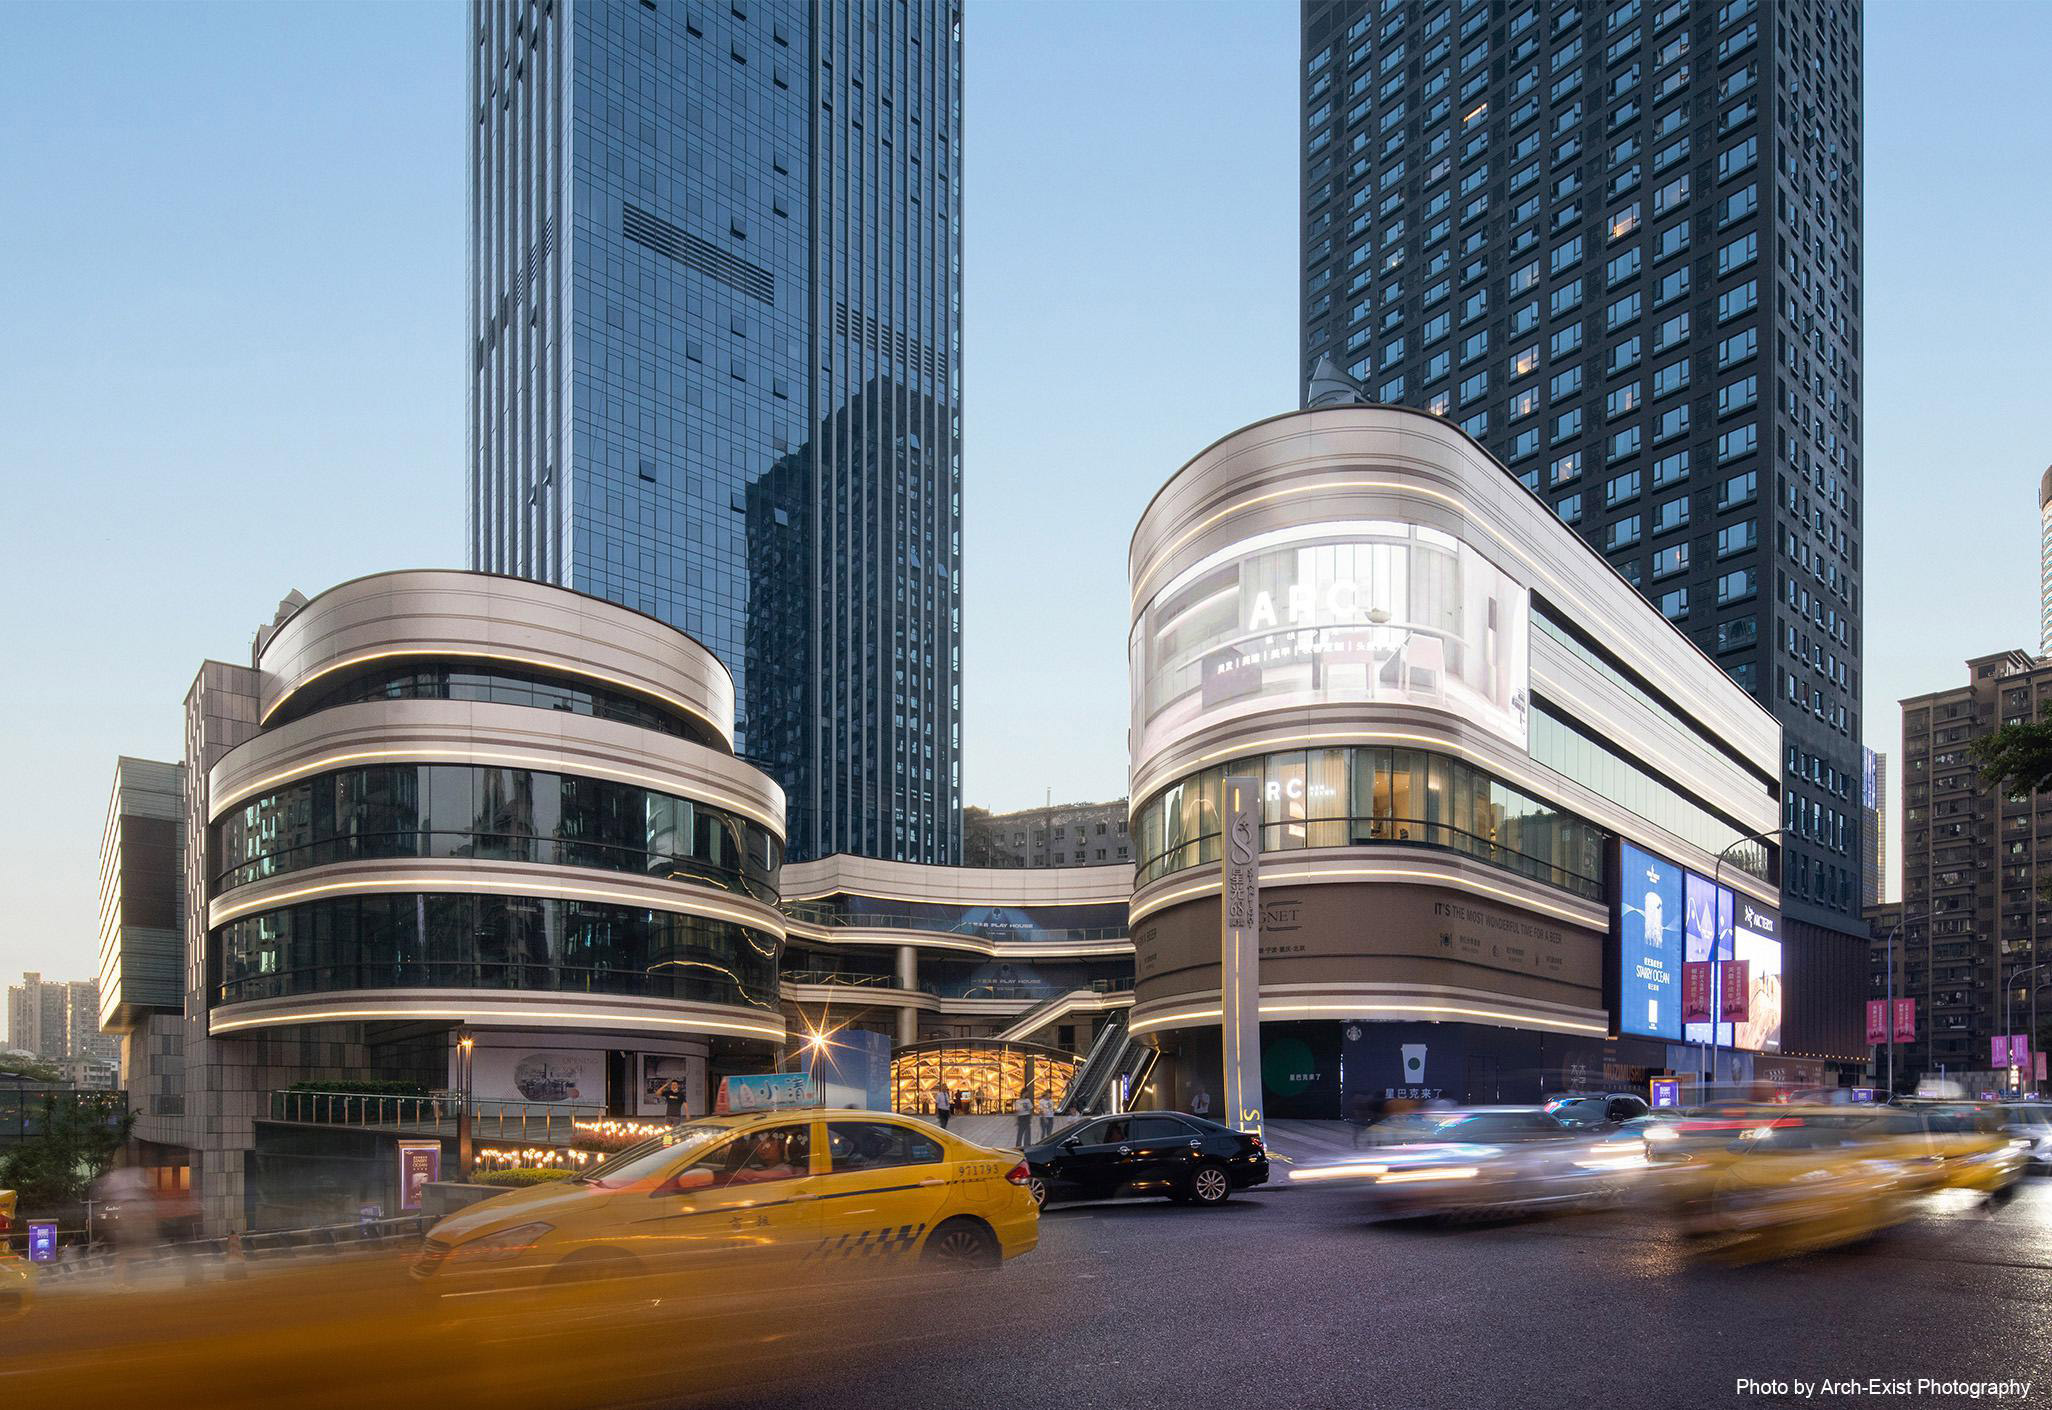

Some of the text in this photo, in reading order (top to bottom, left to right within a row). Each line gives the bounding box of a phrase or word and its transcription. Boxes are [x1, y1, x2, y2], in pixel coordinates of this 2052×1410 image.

[1249, 583, 1359, 631] ARC
[1257, 778, 1303, 803] RC
[1434, 902, 1451, 916] IT'S
[1452, 905, 1465, 920] THE
[1466, 909, 1484, 926] MOST
[1485, 914, 1520, 934] WONDERFUL
[1653, 968, 1670, 985] OCEAN
[1289, 1073, 1321, 1081] 星巴克来了
[1385, 1088, 1443, 1099] 星巴克来了
[959, 1164, 1000, 1177] 971793
